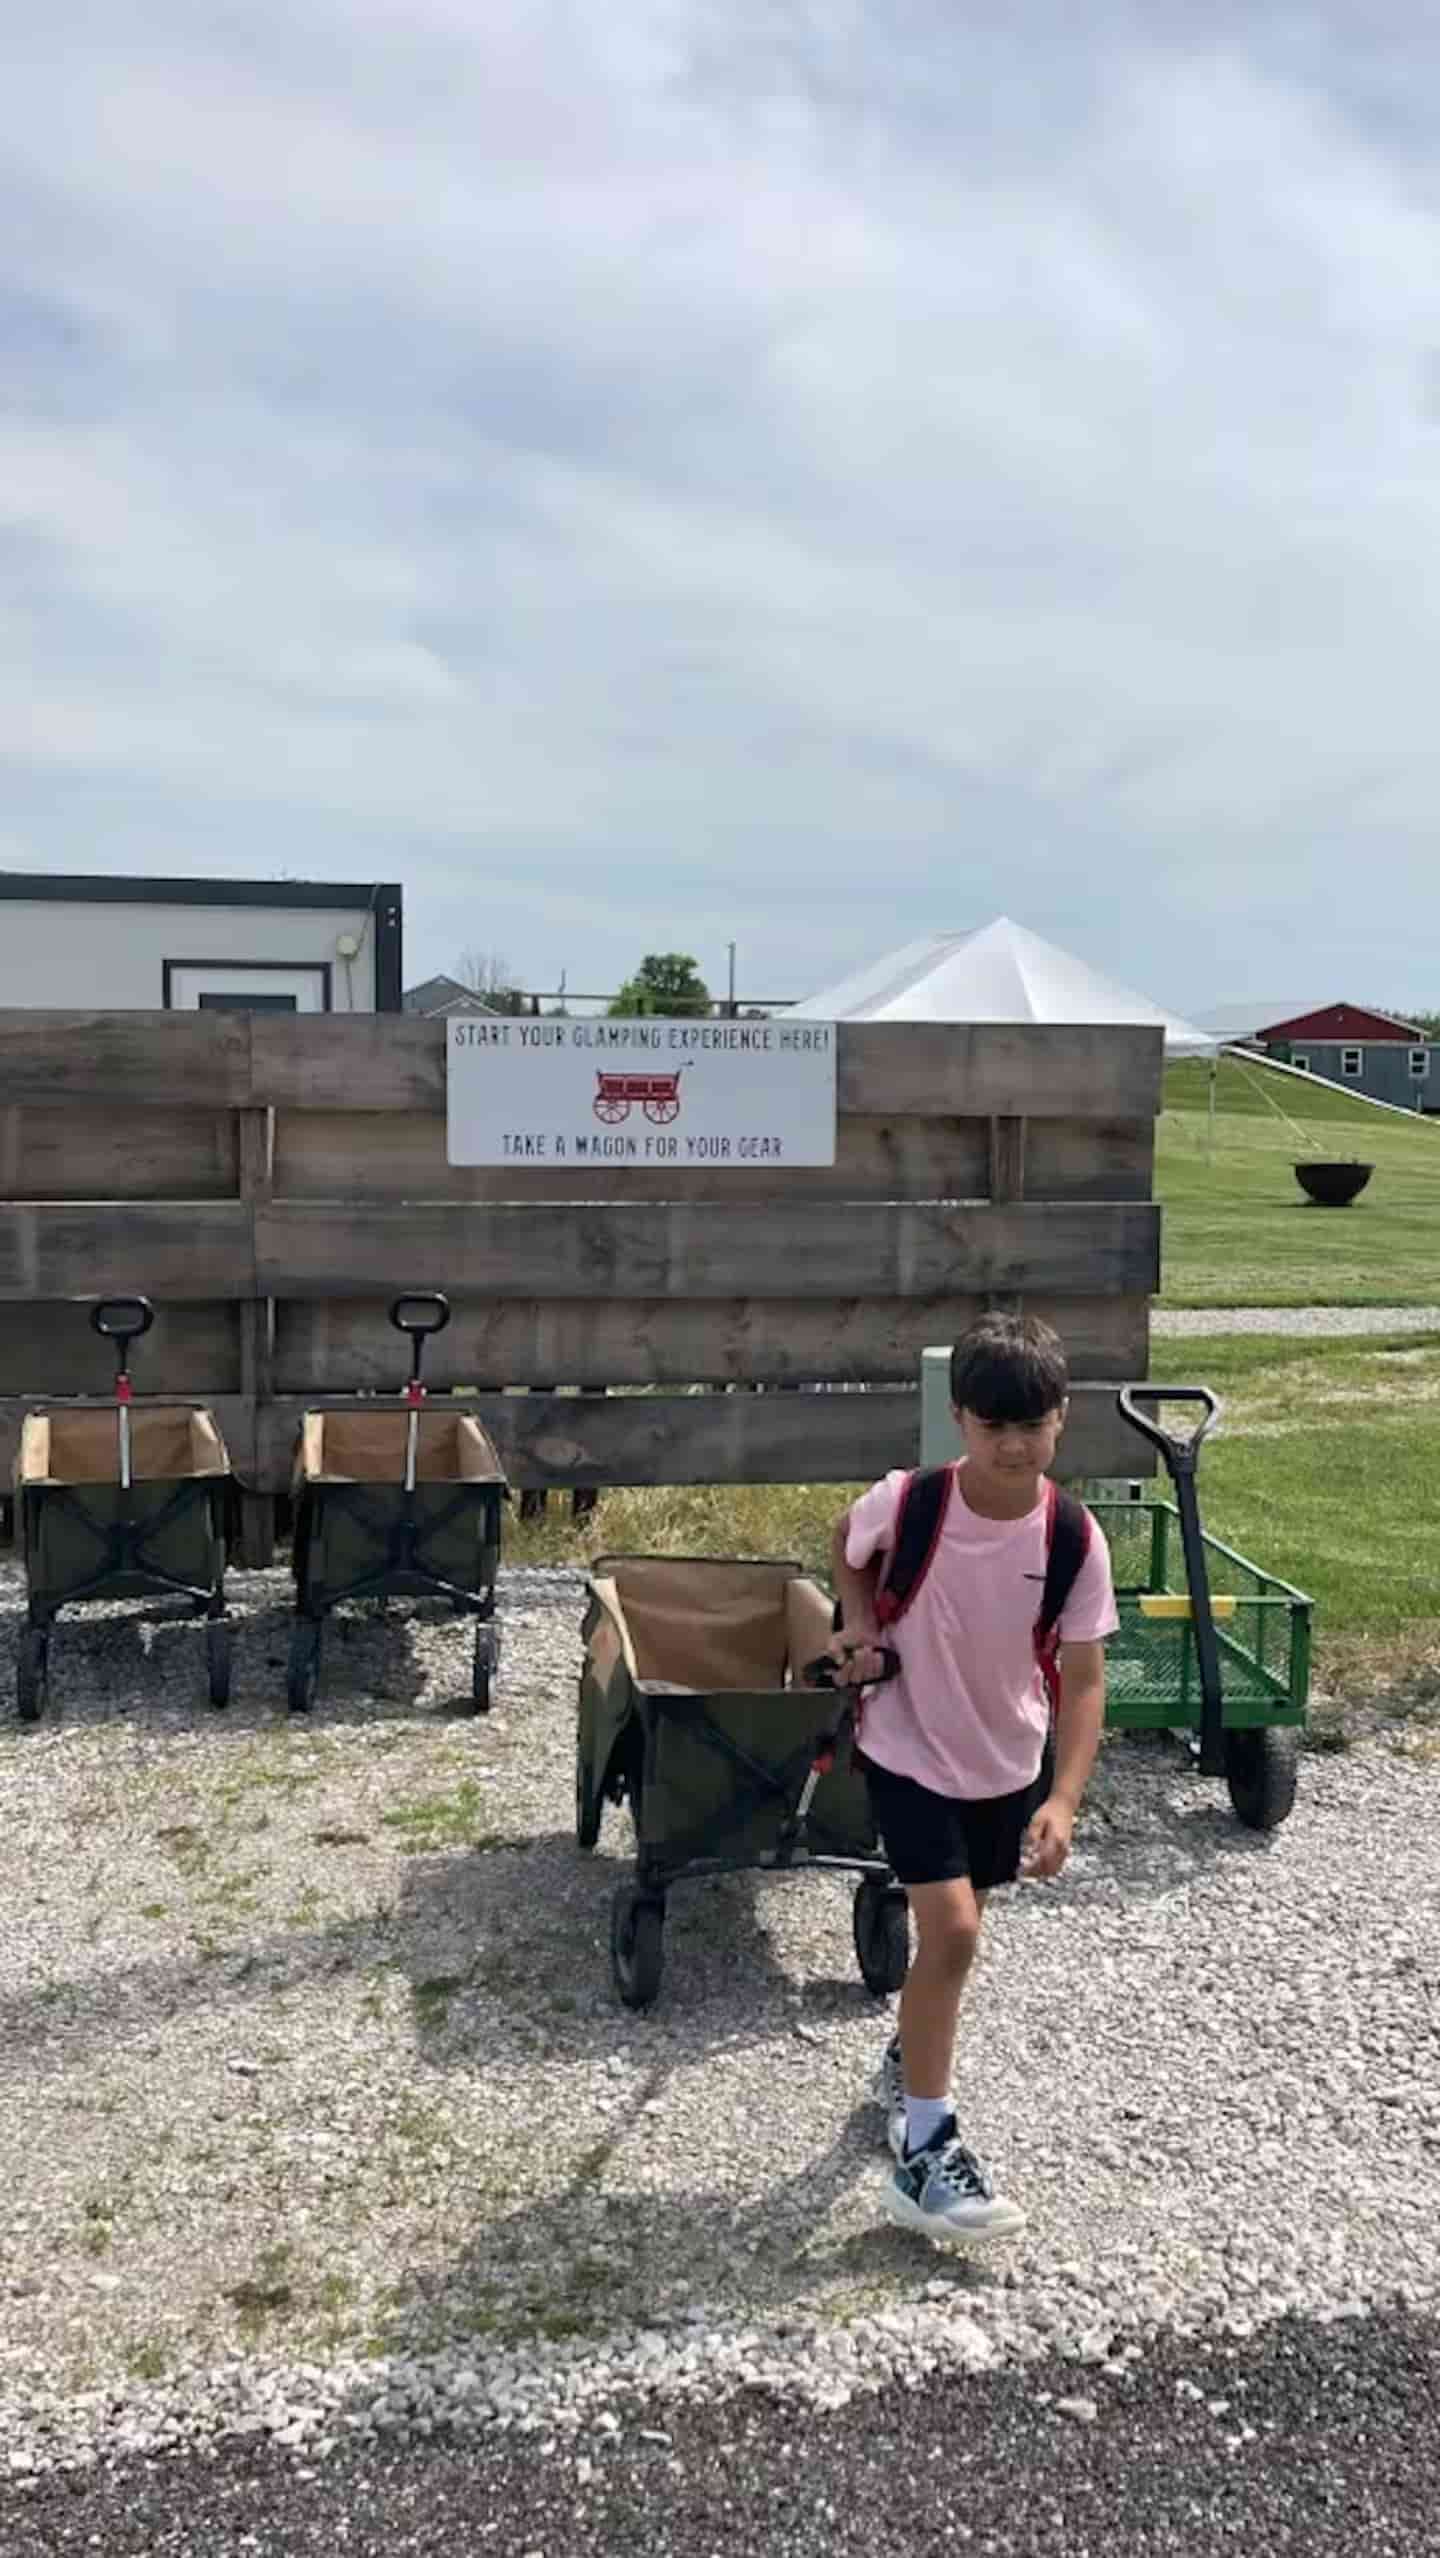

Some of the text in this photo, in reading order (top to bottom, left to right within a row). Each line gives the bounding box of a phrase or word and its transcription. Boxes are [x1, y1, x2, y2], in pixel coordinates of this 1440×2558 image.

[455, 1025, 830, 1051] START YOUR GLAMPING EXPERIENCE HERE!
[502, 1134, 783, 1157] TAKE A WAGON FOR YOUR GEAR
